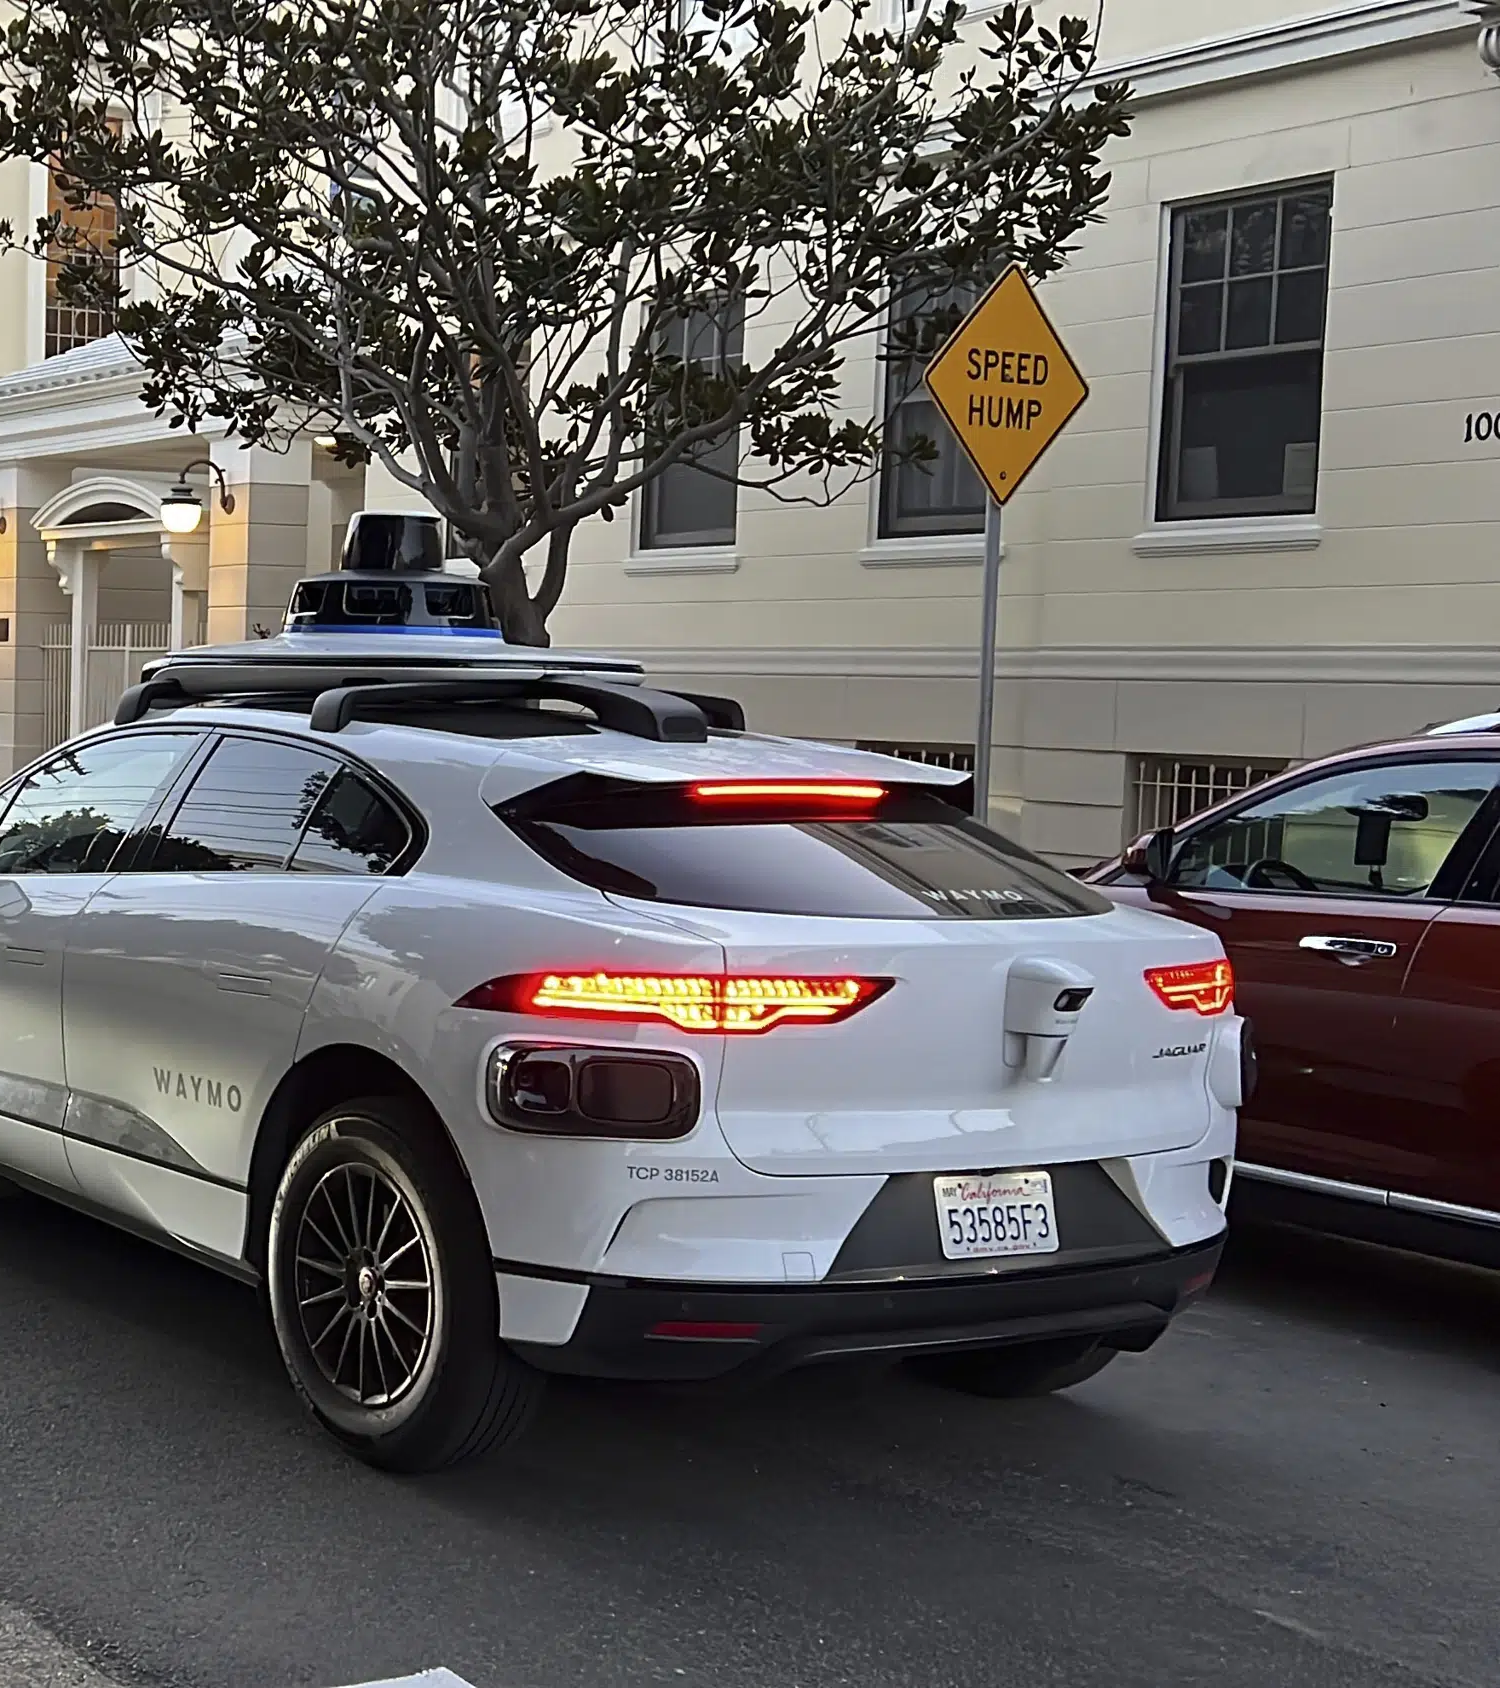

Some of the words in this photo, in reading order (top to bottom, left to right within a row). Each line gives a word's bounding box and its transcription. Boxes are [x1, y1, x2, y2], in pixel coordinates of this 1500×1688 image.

[966, 347, 1049, 386] SPEED
[968, 393, 1043, 431] HUMP
[921, 888, 1024, 901] WAYMO
[1151, 1043, 1206, 1059] JAGUAR
[152, 1065, 242, 1113] WAYMO
[626, 1165, 660, 1180] TCP
[664, 1168, 719, 1182] 38152A
[942, 1186, 957, 1198] MAY
[960, 1181, 1031, 1204] California
[947, 1202, 1049, 1245] 53585F3
